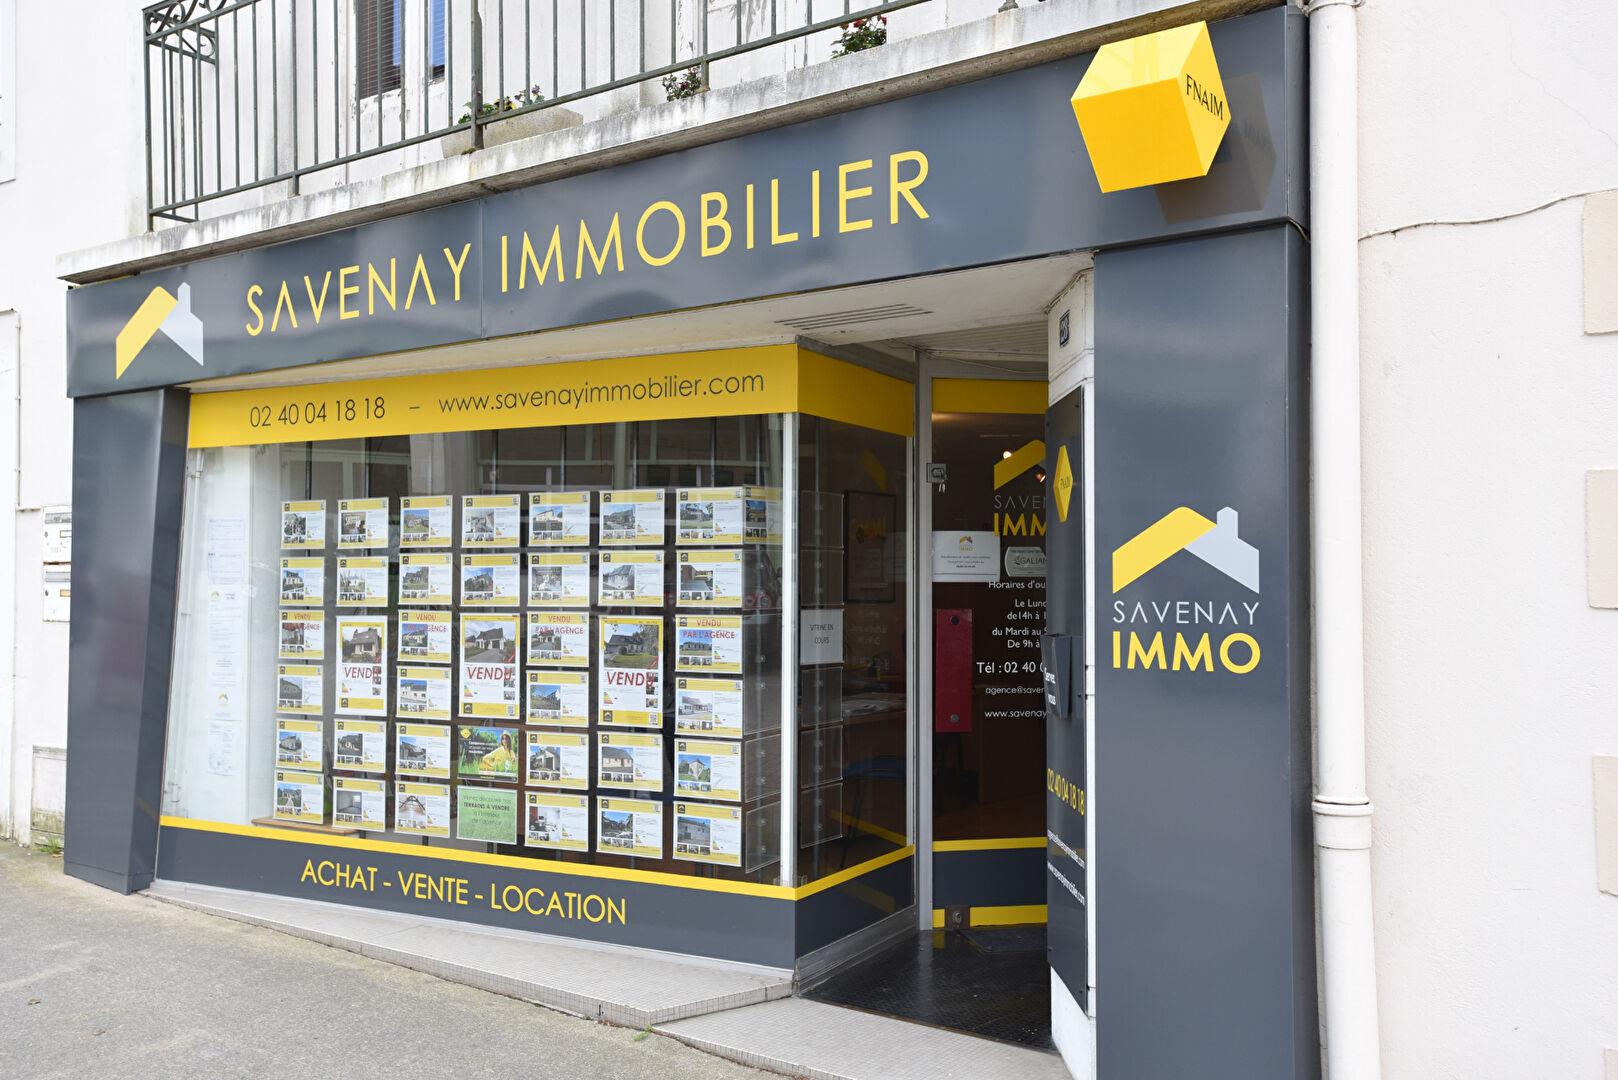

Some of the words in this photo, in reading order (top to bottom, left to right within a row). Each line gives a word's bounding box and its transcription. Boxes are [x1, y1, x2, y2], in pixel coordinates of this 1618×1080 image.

[1186, 73, 1223, 120] FNAIM
[245, 242, 471, 337] SAVENAY
[501, 150, 929, 293] IMMOBILIER
[250, 405, 272, 428] 02
[277, 403, 300, 425] 40
[304, 401, 327, 424] 04
[336, 399, 356, 422] 18
[365, 396, 386, 420] 18
[438, 374, 764, 413] www.savenayimmobilier.com
[994, 495, 1046, 509] SAVE
[988, 580, 1025, 589] Horaires
[1015, 599, 1025, 608] Le
[547, 615, 571, 623] VENDU
[1112, 600, 1259, 625] SAVENAY
[696, 619, 722, 627] VENDU
[992, 627, 1003, 636] du
[1005, 627, 1030, 636] Mardi
[1031, 628, 1042, 636] au
[1007, 639, 1020, 648] De
[1023, 639, 1034, 648] 9h
[1112, 631, 1261, 675] IMMO
[467, 666, 513, 680] VENDU
[976, 661, 995, 674] Tél
[1003, 661, 1018, 673] 02
[1022, 661, 1037, 673] 40
[606, 671, 656, 687] VENDU
[300, 858, 378, 892] ACHAT
[397, 871, 469, 905] VENTE
[490, 882, 627, 926] LOCATION
